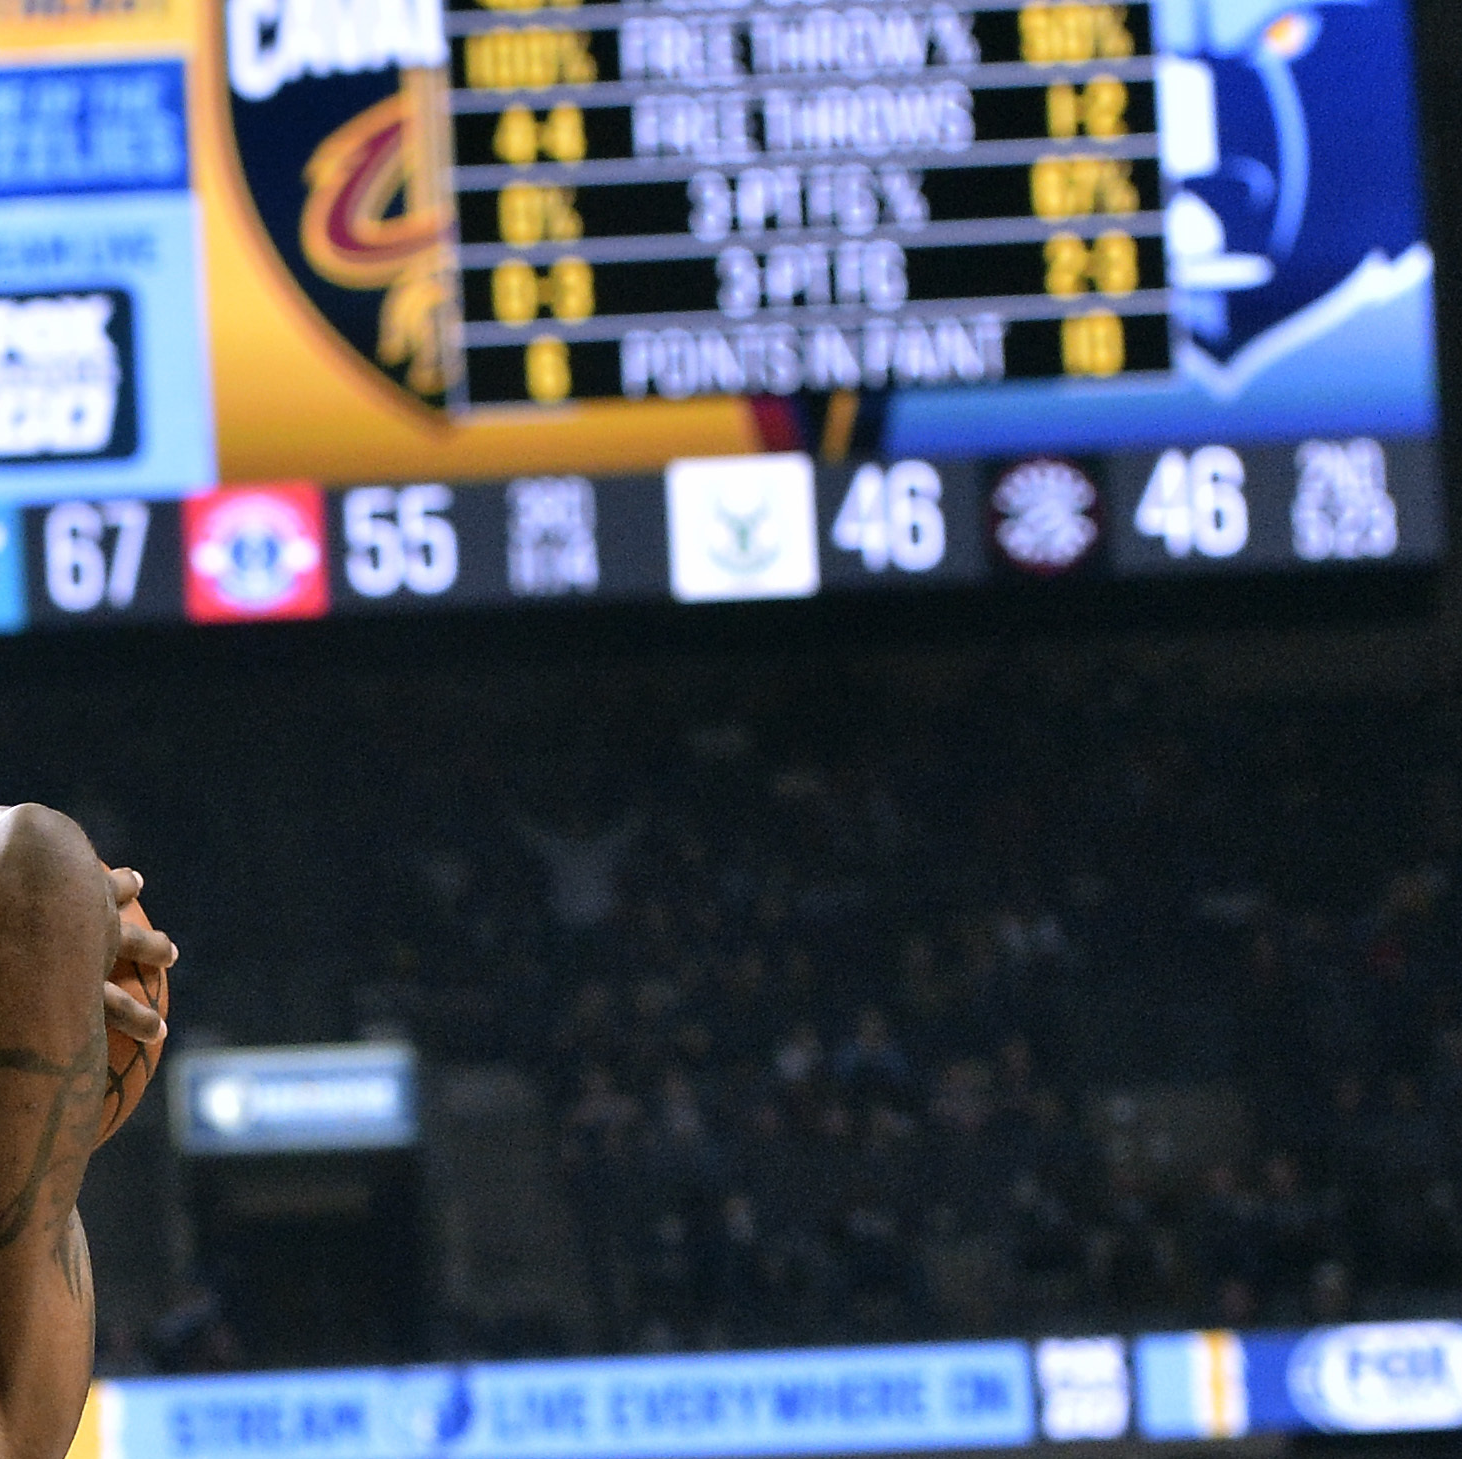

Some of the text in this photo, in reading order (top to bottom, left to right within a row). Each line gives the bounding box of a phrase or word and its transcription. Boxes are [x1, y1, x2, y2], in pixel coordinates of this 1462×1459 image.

[43, 499, 150, 613] 67
[343, 483, 459, 597] 55
[832, 458, 946, 572] 46
[1134, 444, 1250, 558] 46
[165, 1398, 369, 1454] STREAM
[610, 1370, 927, 1432] EVERYWHERE
